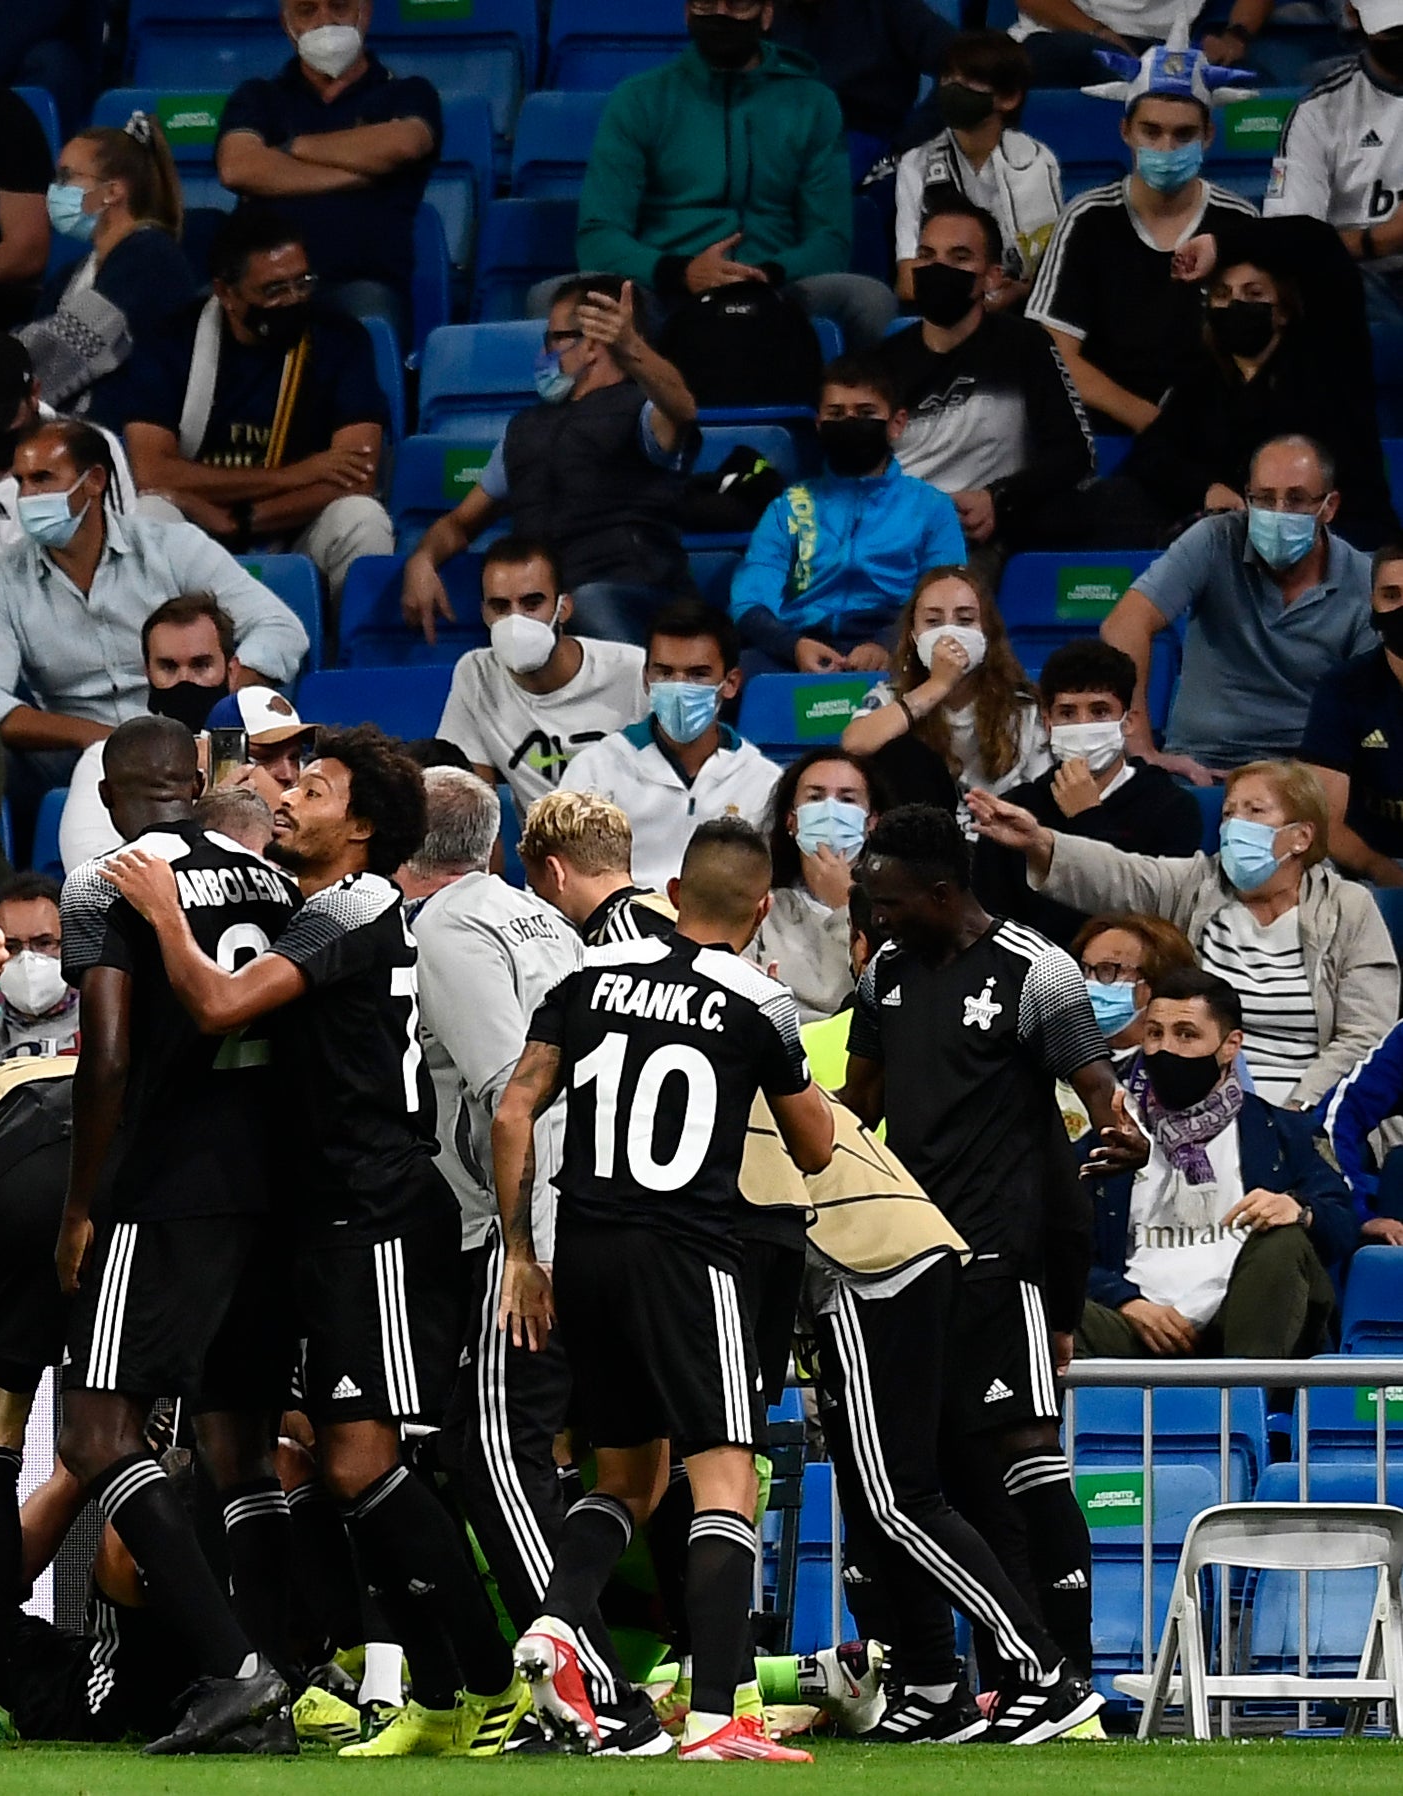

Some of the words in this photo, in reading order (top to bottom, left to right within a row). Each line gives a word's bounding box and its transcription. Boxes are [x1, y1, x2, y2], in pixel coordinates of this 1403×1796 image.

[176, 867, 293, 909] ARBOLEDA
[574, 1032, 717, 1192] 10
[1087, 1497, 1142, 1508] DISPONIBLE
[1095, 1490, 1135, 1500] ASIENTO
